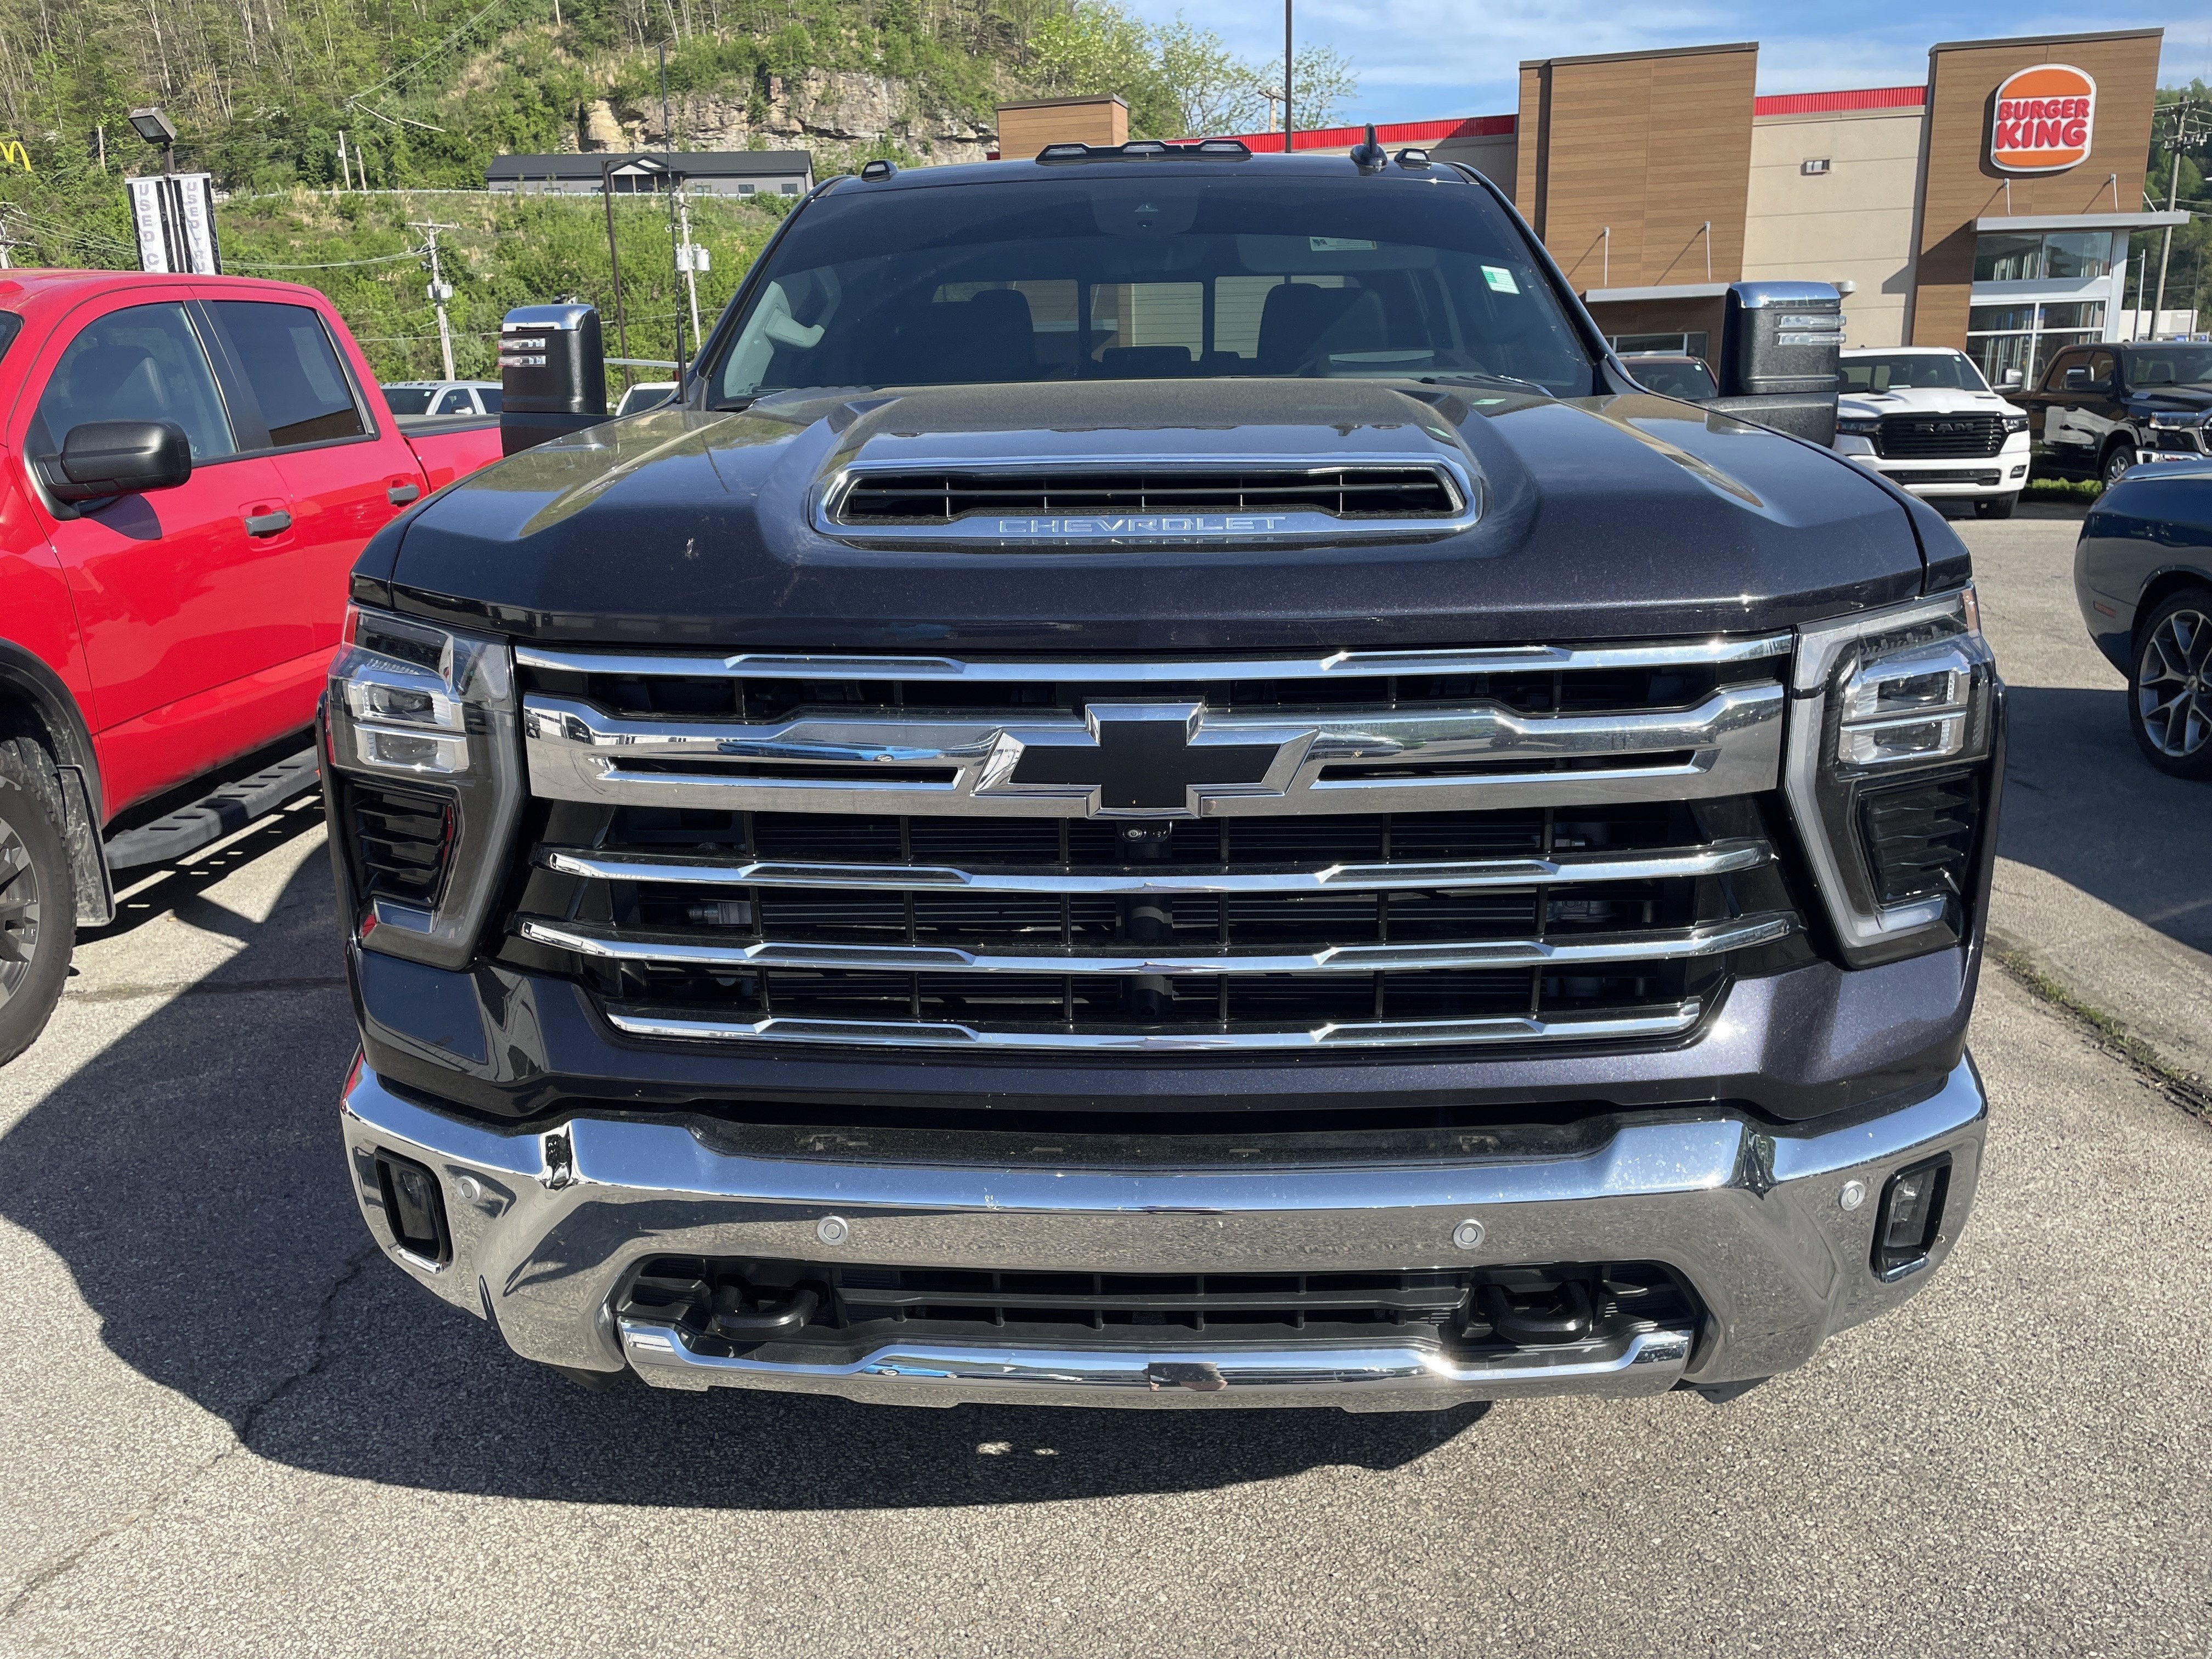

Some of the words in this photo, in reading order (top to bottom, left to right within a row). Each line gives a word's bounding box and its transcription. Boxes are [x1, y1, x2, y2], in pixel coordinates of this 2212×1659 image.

[1999, 98, 2090, 121] BURGER
[1996, 119, 2087, 149] KING
[139, 184, 155, 242] USED
[187, 182, 200, 229] USED
[1915, 422, 1974, 433] RAM
[999, 516, 1286, 533] CHEVROLET
